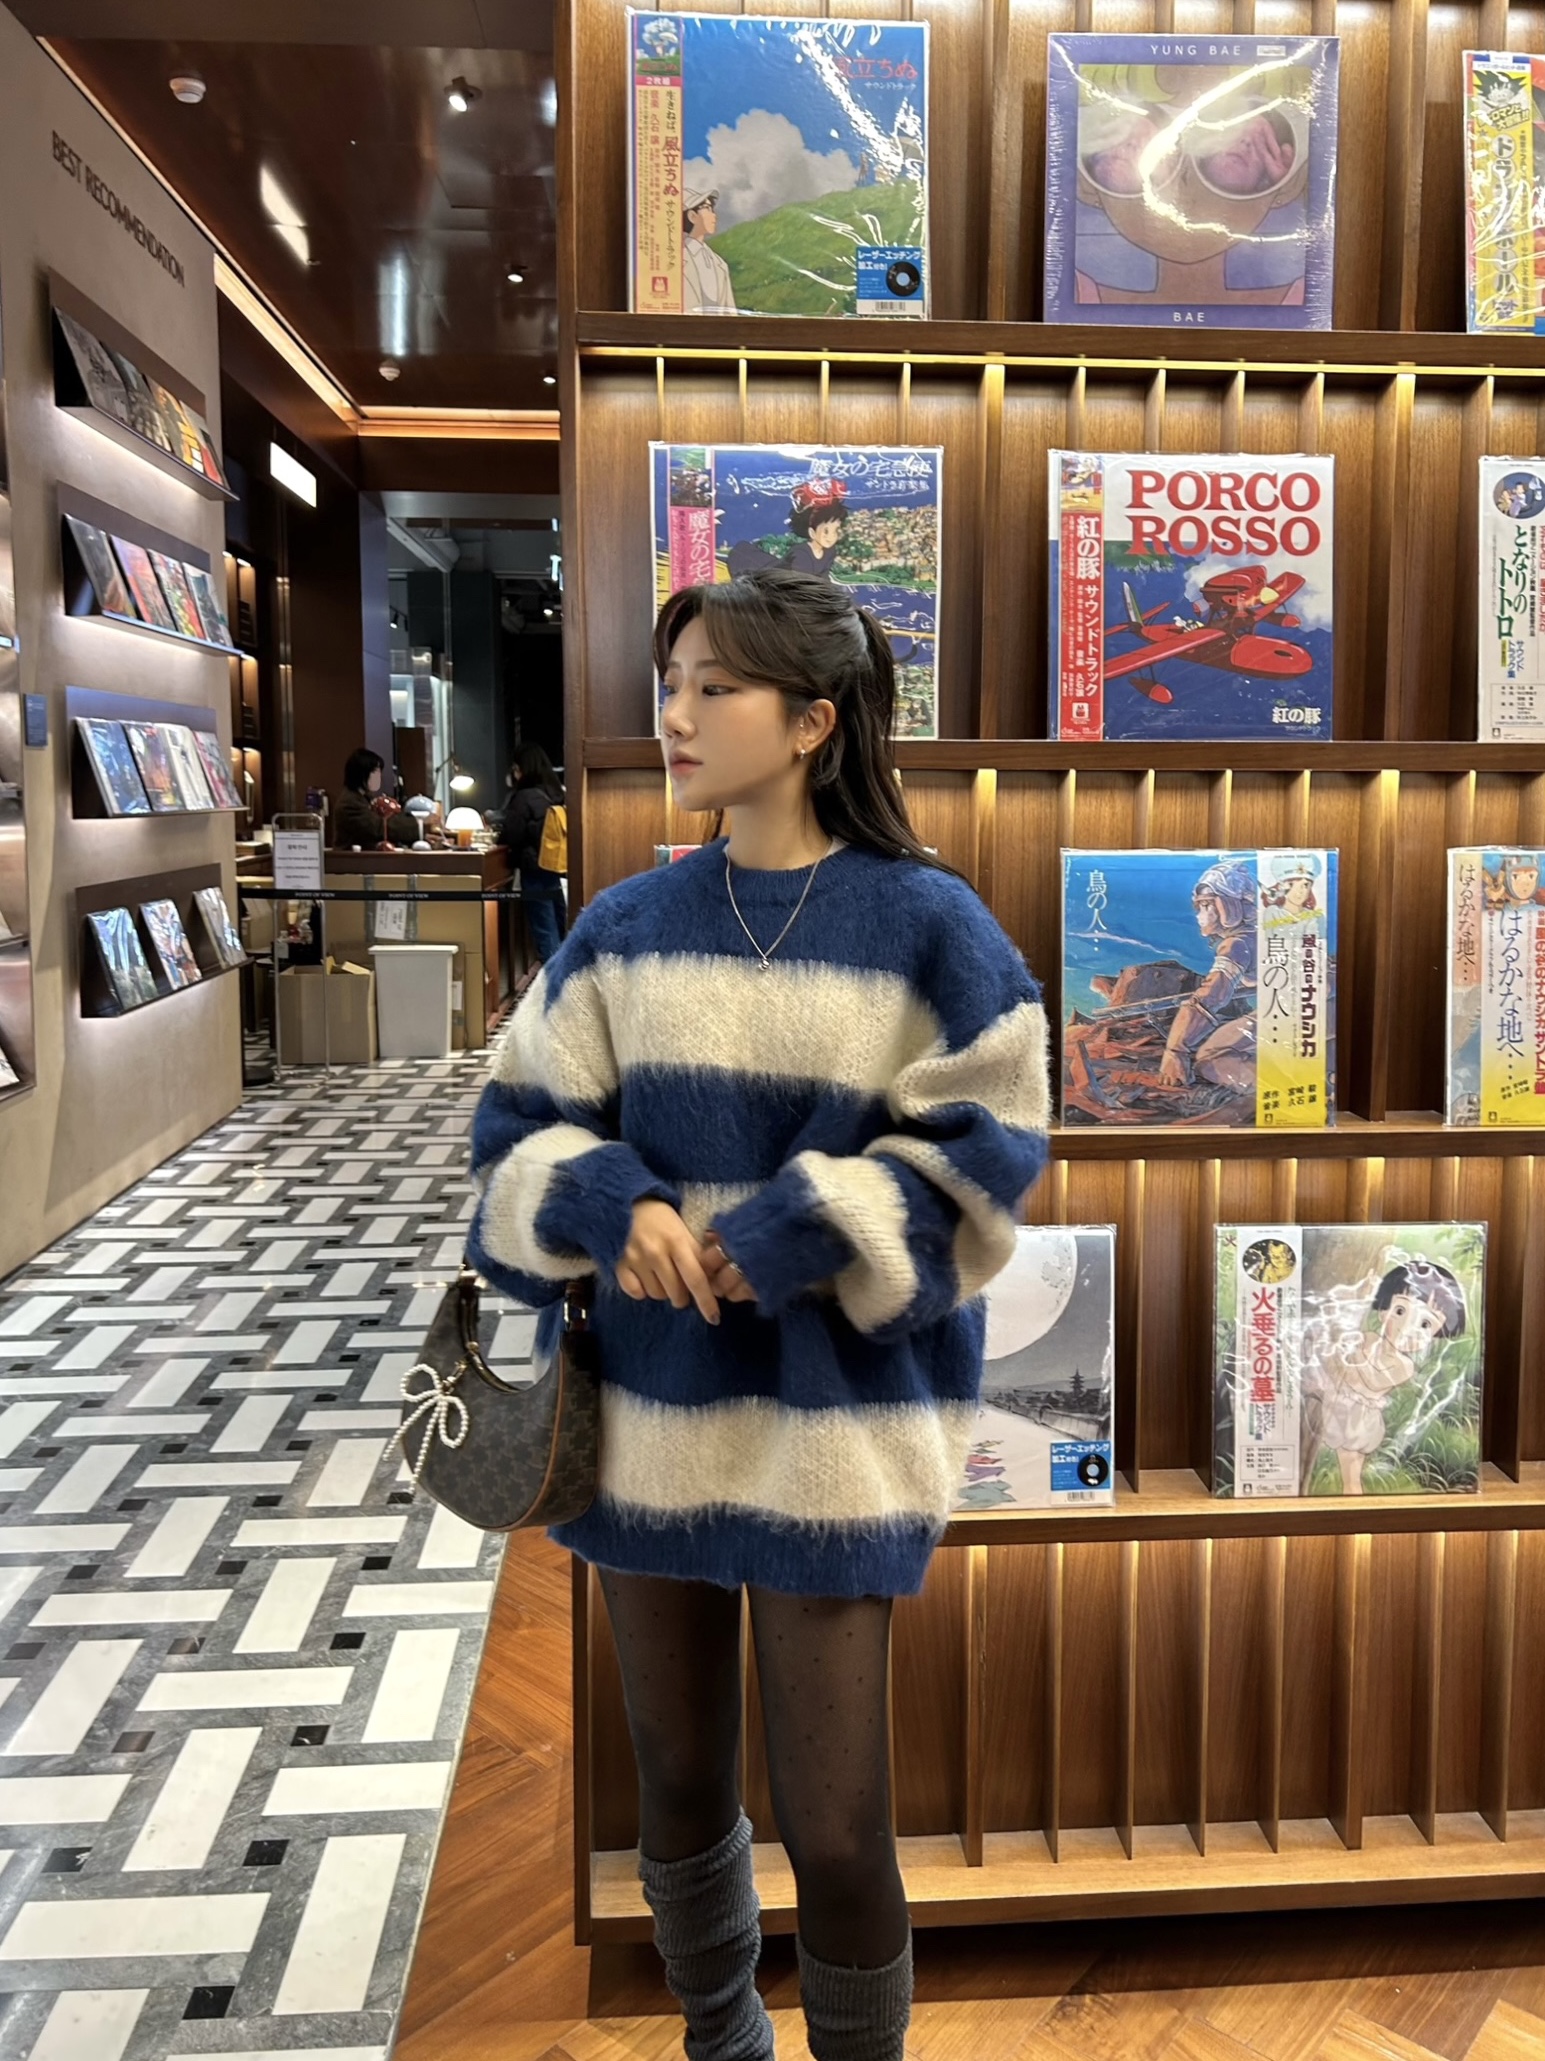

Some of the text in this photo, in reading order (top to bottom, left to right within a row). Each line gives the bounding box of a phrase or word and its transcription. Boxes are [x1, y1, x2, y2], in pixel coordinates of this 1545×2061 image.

[1151, 45, 1241, 55] YUNG BAE
[662, 136, 680, 196] 風立ちぬ
[53, 129, 185, 288] BEST RECOMMENDATION
[1173, 312, 1205, 322] BAE
[1125, 469, 1321, 512] PORCO
[1076, 515, 1100, 580] 紅の豚
[1125, 515, 1321, 556] ROSSO
[1496, 557, 1514, 640] トトロ
[1512, 524, 1530, 614] となりの
[1085, 584, 1099, 697] サウンドトラック
[1272, 706, 1321, 724] 紅の豚
[1301, 933, 1318, 1058] 風の谷のナウシカ
[1250, 1287, 1276, 1402] 火垂るの墓
